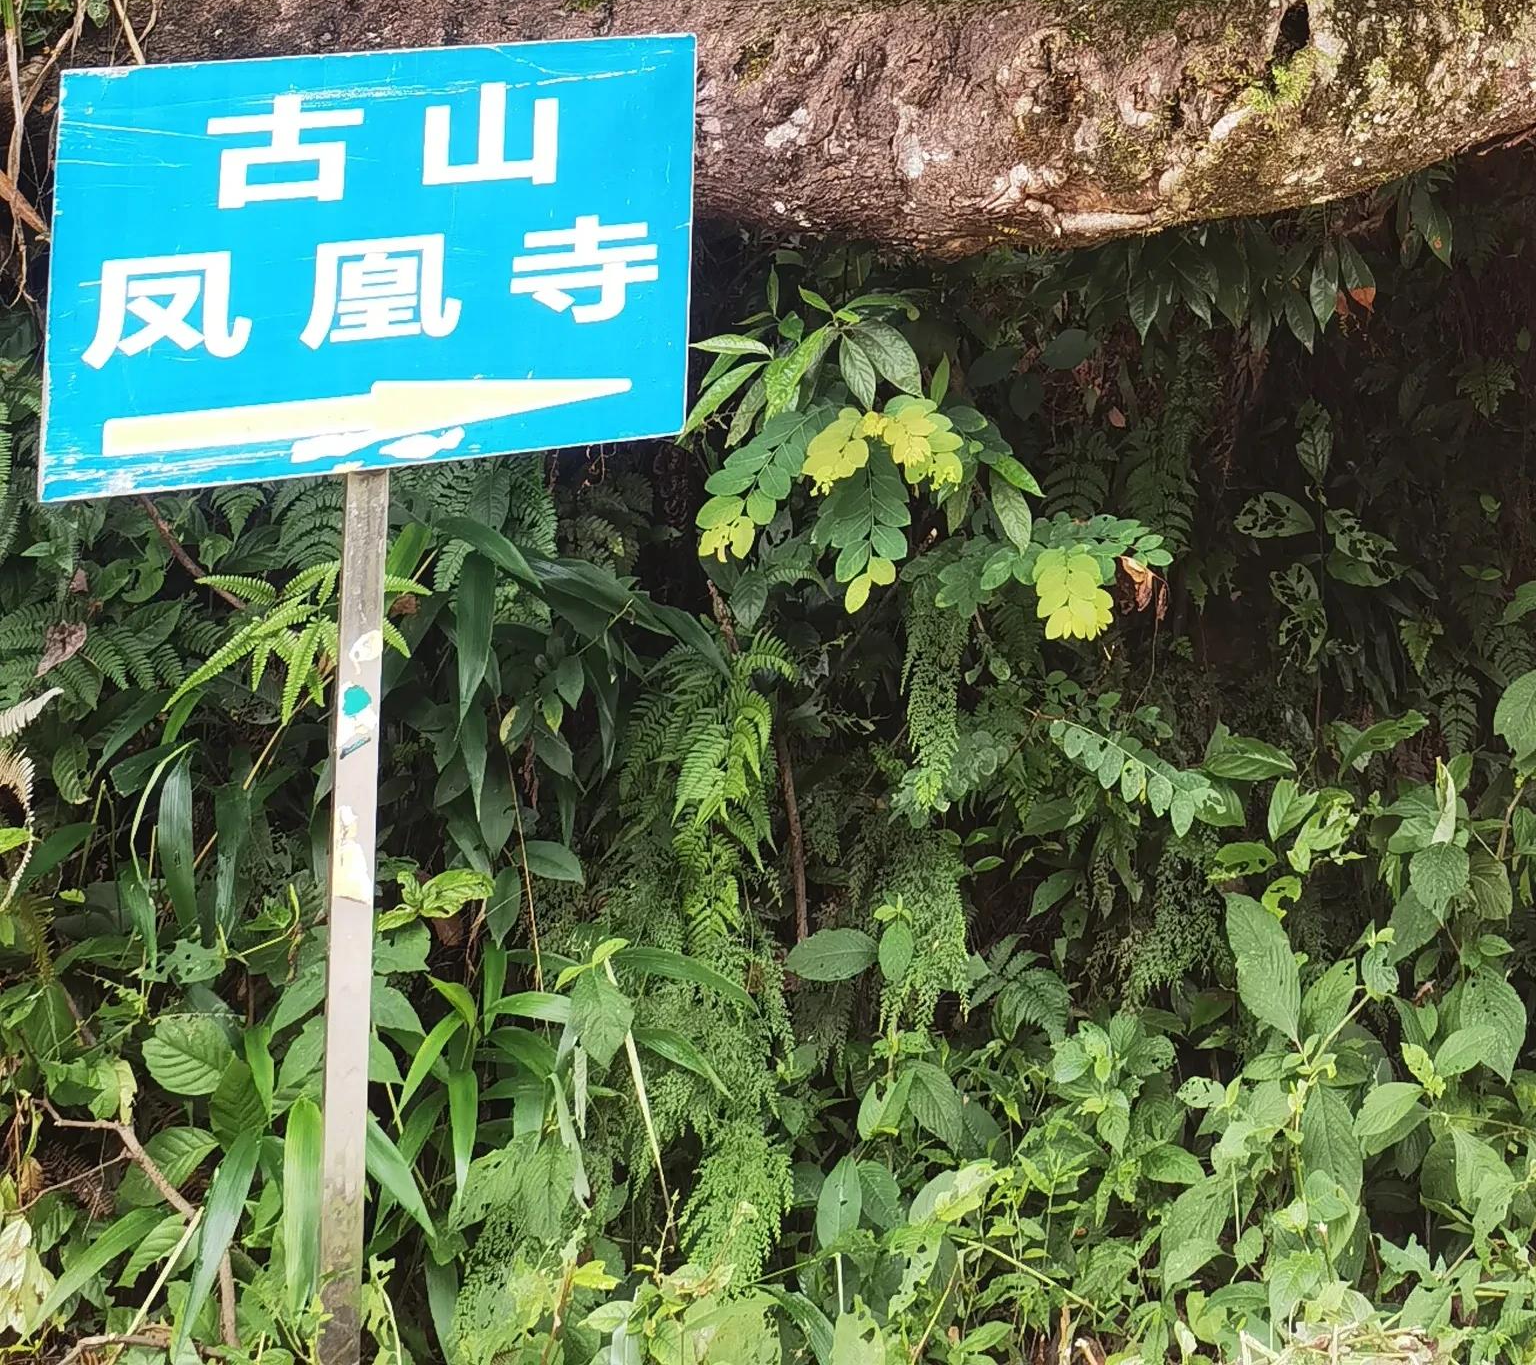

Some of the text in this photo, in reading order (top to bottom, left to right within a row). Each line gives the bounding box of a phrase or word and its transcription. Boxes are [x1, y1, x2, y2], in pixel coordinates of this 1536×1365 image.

[206, 82, 559, 209] 古山
[81, 215, 658, 369] 凤凰寺
